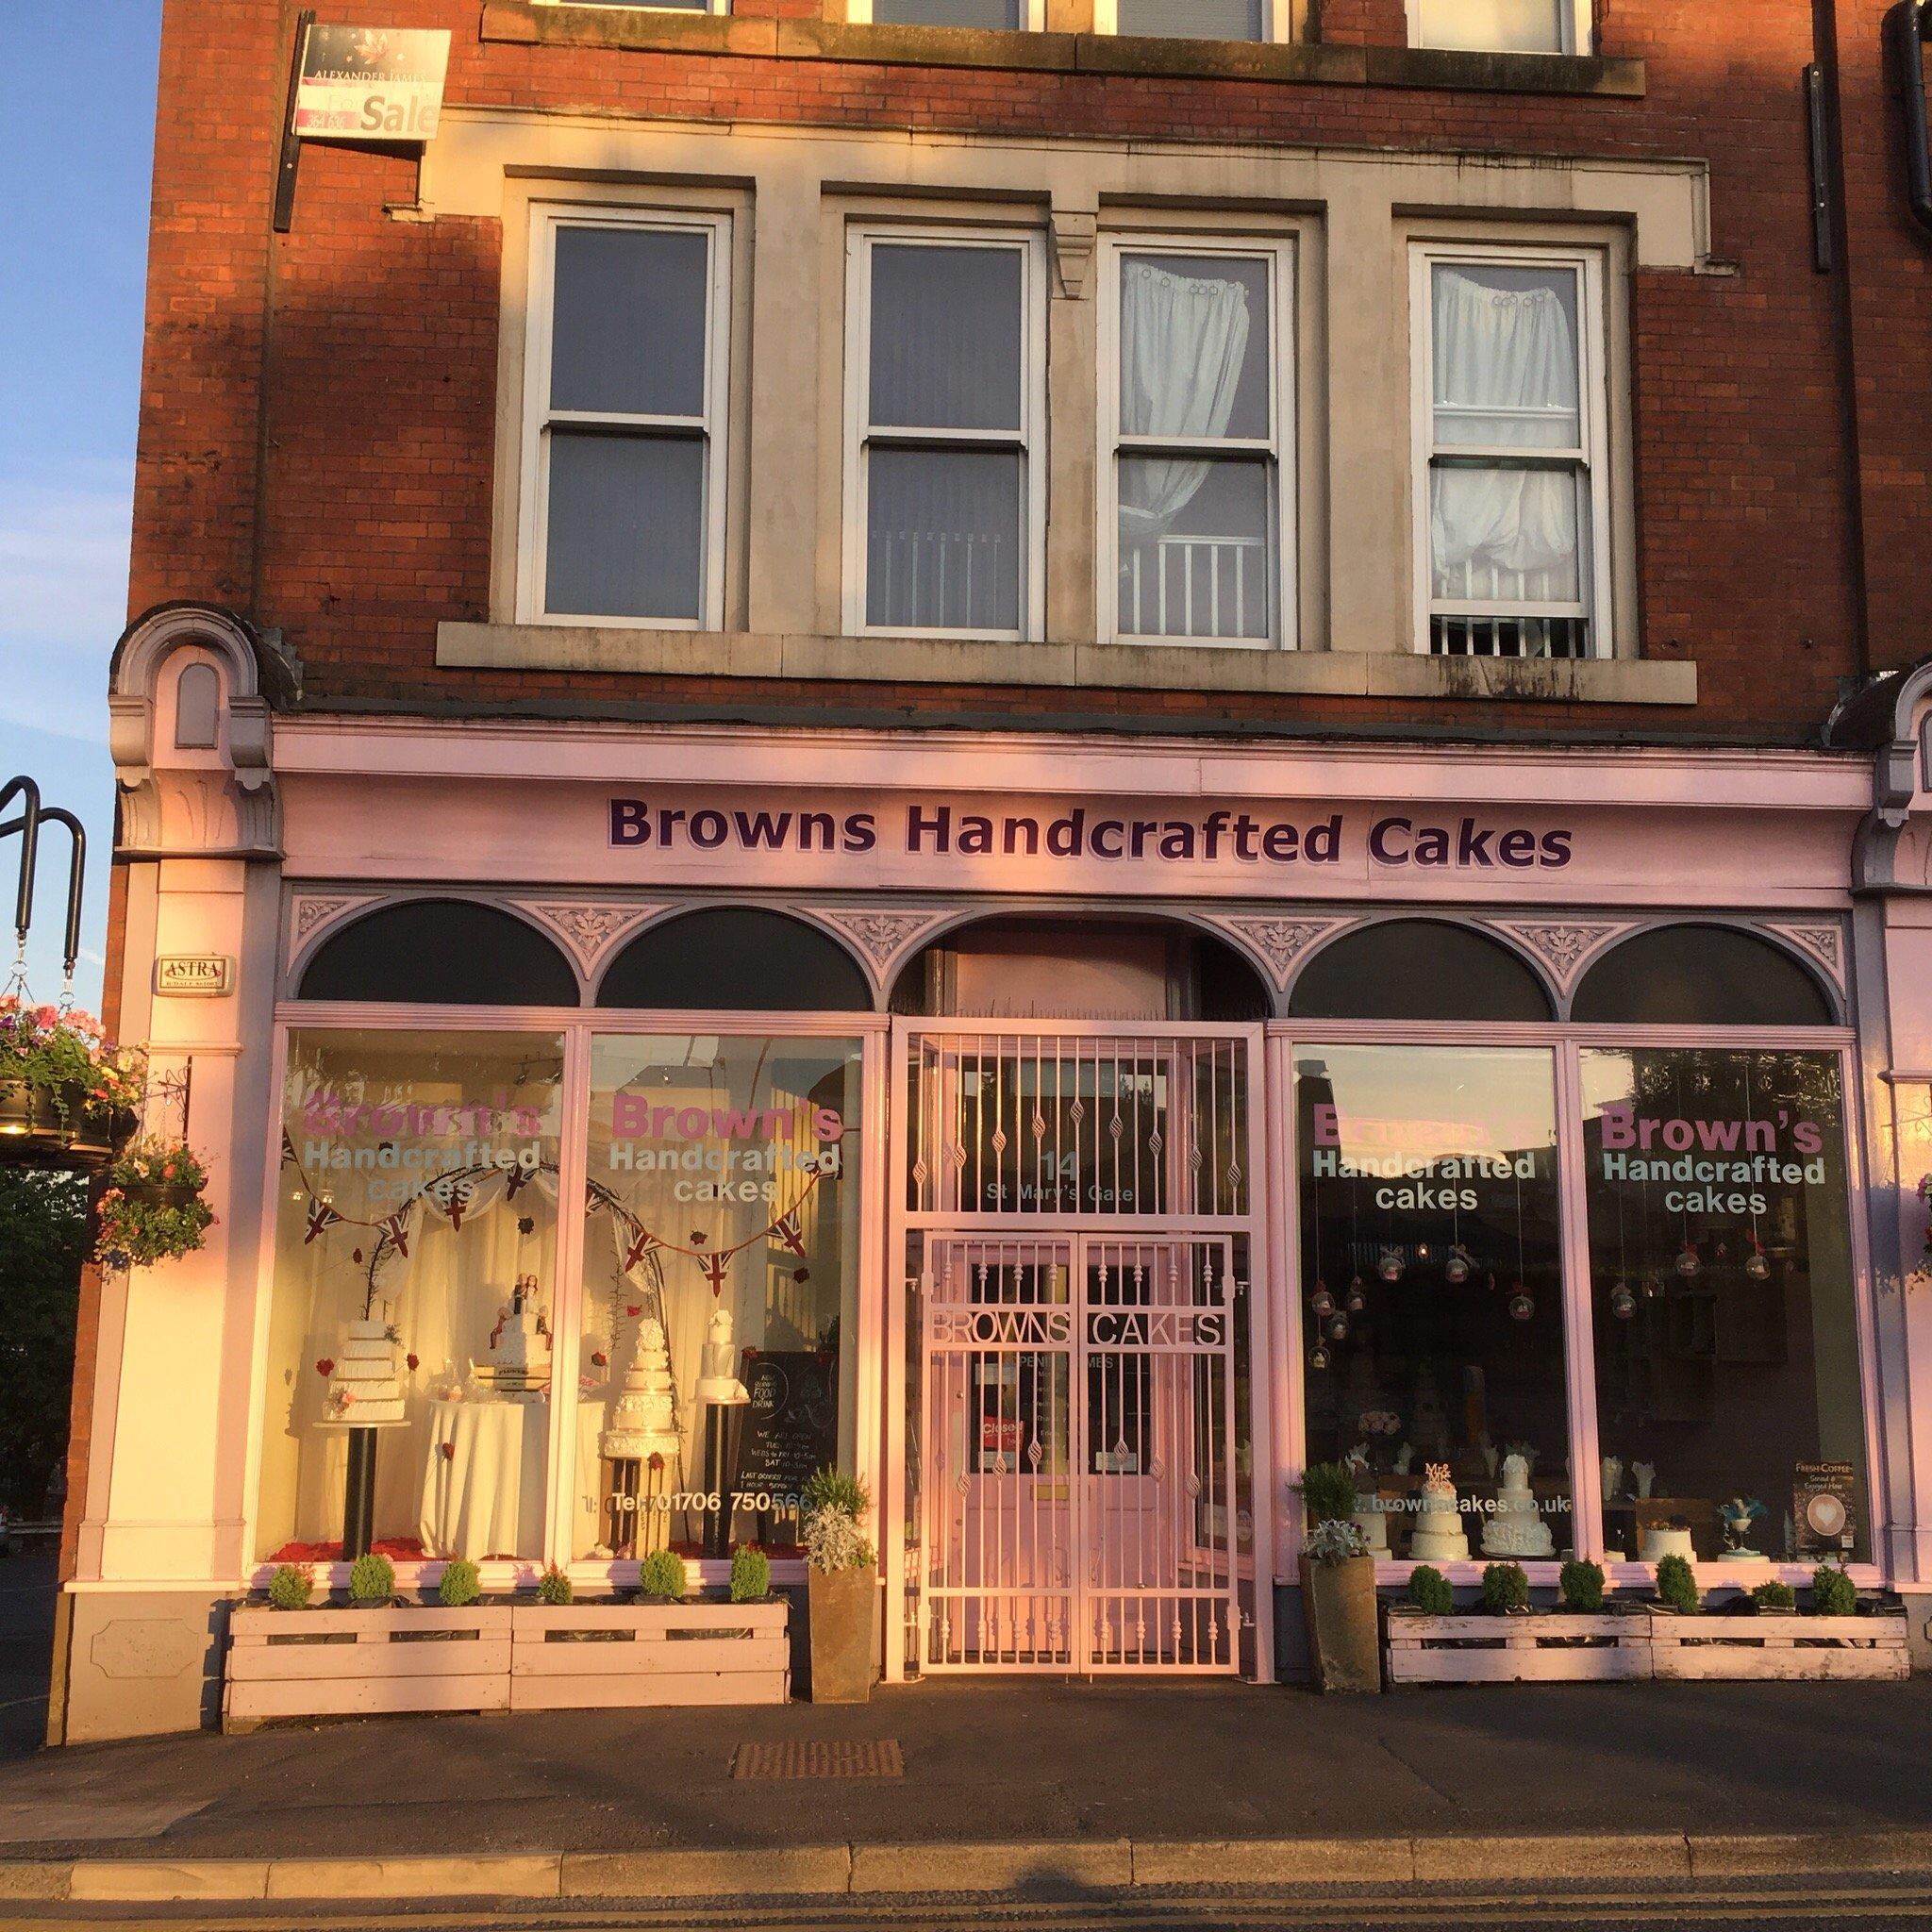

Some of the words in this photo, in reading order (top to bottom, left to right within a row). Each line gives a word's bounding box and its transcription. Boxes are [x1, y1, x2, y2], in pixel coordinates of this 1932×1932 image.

[314, 69, 386, 82] ALEXANDER
[360, 95, 439, 133] Sale
[610, 798, 876, 850] Browns
[906, 806, 1343, 863] Handcrafted
[1369, 817, 1573, 867] Cakes
[169, 961, 218, 977] ASTRA
[612, 1093, 844, 1142] Brown's
[1601, 1105, 1823, 1153] Brown's
[304, 1141, 541, 1170] Handcrafted
[609, 1142, 841, 1172] Handcrafted
[1041, 1150, 1078, 1181] 14
[1312, 1149, 1536, 1180] Handcrafted
[1603, 1153, 1826, 1184] Handcrafted
[366, 1175, 474, 1203] cakes
[674, 1175, 778, 1203] cakes
[987, 1182, 1008, 1200] St
[1019, 1183, 1077, 1203] Mary's
[1375, 1181, 1478, 1210] cakes
[1665, 1185, 1767, 1215] cakes
[930, 1311, 1071, 1344] BROWNS
[1092, 1312, 1221, 1345] CAKES
[1795, 1462, 1820, 1473] FRESH
[1821, 1463, 1853, 1473] COFFEE
[657, 1491, 722, 1512] 01706
[730, 1491, 812, 1512] 750566
